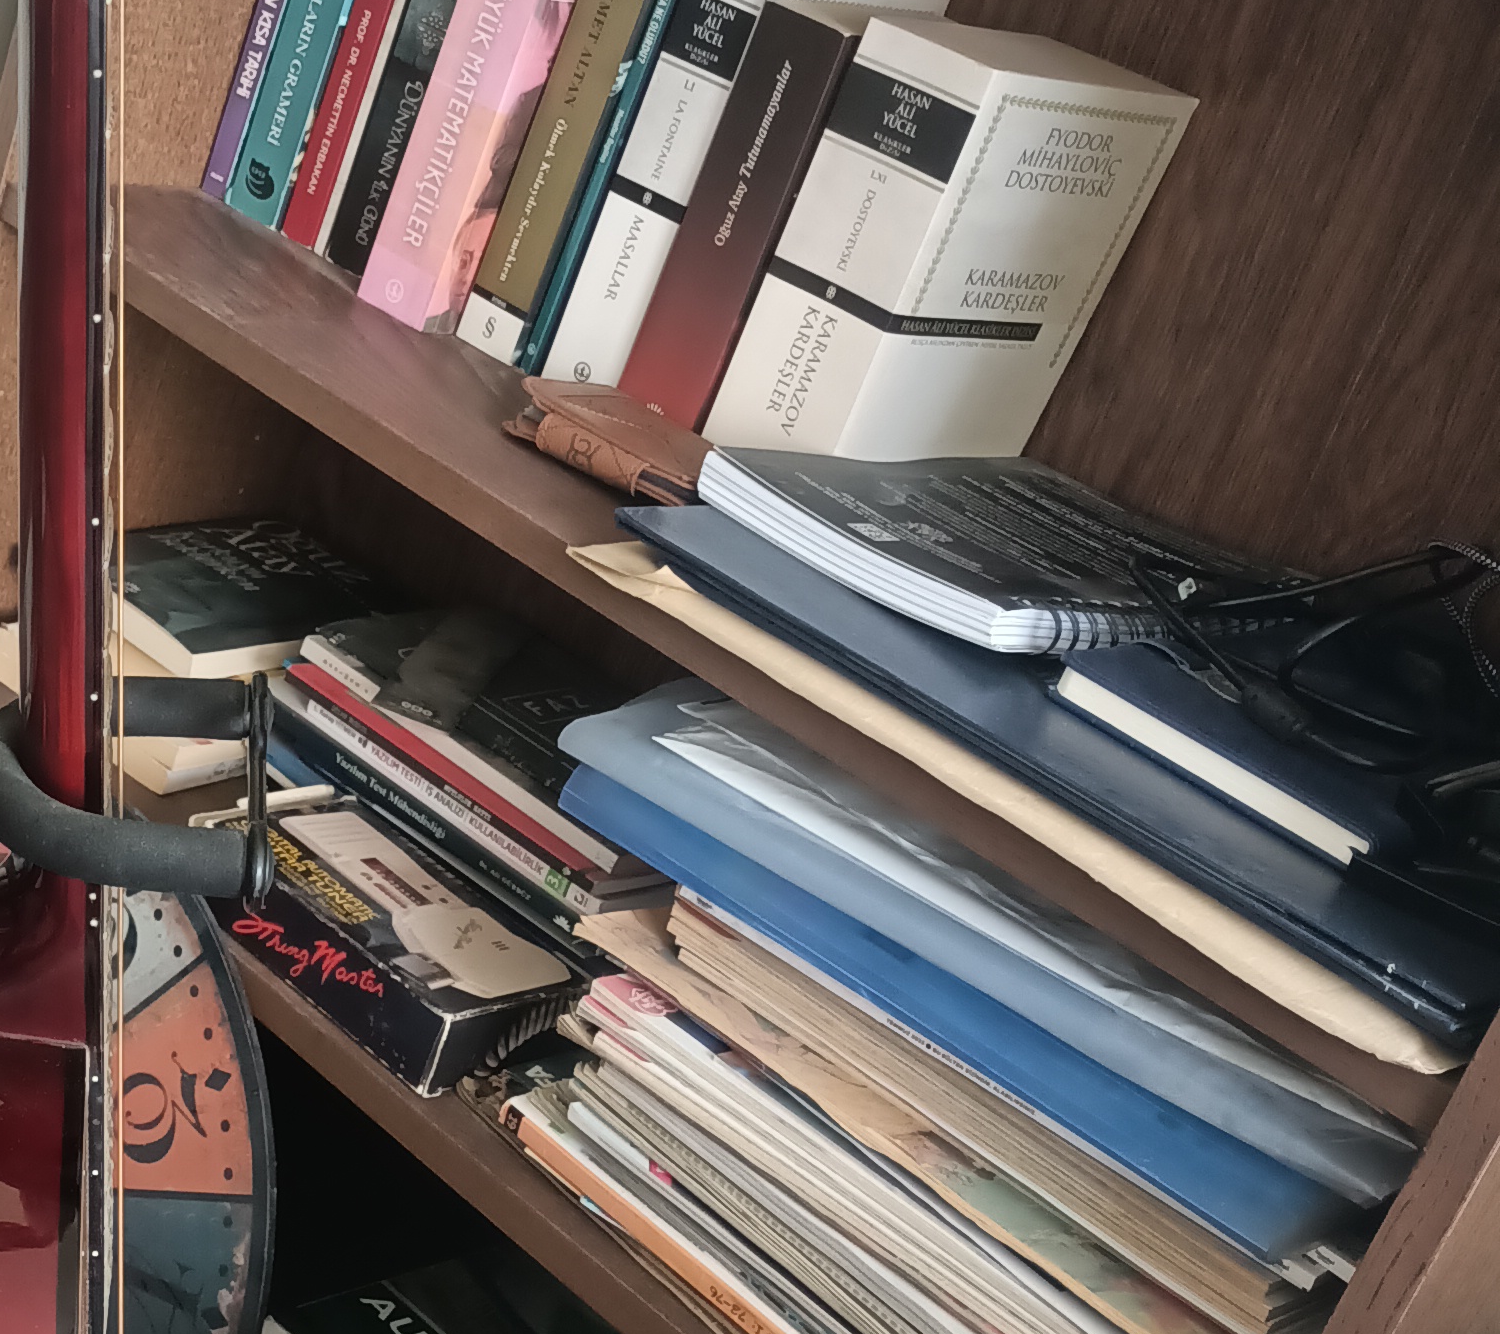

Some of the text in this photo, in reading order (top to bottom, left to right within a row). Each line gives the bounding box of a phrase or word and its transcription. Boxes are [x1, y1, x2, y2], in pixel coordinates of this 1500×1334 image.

[252, 9, 276, 47] KISA
[266, 58, 303, 147] GRAMERİ
[306, 9, 373, 196] PROF. NECMETTİN ERBAKAN
[563, 51, 593, 109] ALTAN
[891, 82, 933, 111] HASAN
[379, 81, 424, 178] DÜNYANIN
[402, 51, 486, 250] MATEMATİKÇİLER
[650, 99, 688, 182] LA FONTAINE
[713, 58, 794, 248] Oğuz Atay Tutunamayanlar
[1016, 146, 1124, 179] MİHAYLOVİÇ
[1045, 126, 1114, 153] FYODOR
[499, 117, 569, 282] Ölmek Sevmekten
[869, 168, 888, 185] LXI
[1004, 169, 1117, 199] DOSTOYEVSKİ
[603, 214, 645, 302] MASALLAR
[964, 268, 1066, 291] KARAMAZOV
[960, 290, 1049, 315] KARDEŞLER
[764, 303, 822, 414] KARDEŞLER
[780, 312, 839, 438] KARAMAZOV
[370, 745, 402, 774] YAZILIM
[335, 752, 369, 783] Yazılım
[368, 775, 388, 796] Test
[387, 790, 448, 841] Mühendisliği
[309, 870, 375, 923] TUNER
